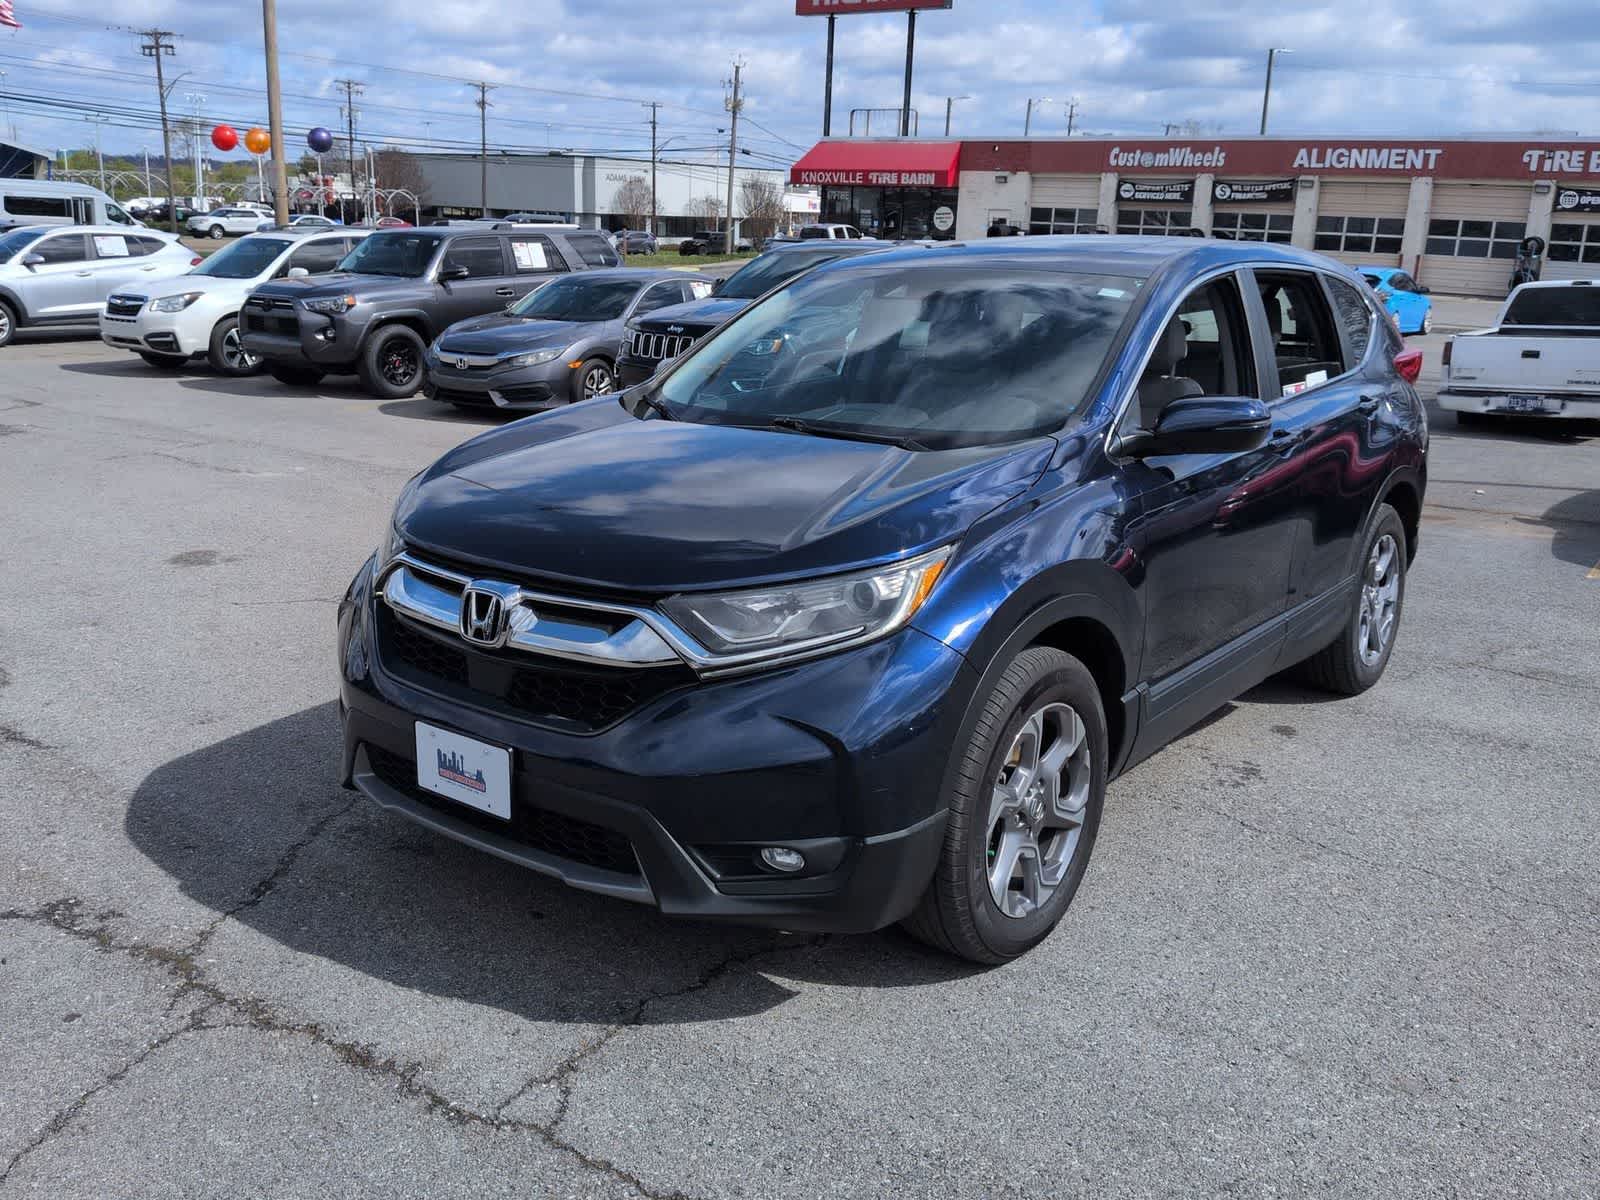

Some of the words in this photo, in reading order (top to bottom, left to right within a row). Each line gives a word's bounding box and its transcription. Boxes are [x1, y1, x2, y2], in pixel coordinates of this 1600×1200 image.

[1292, 147, 1443, 169] ALIGNMENT
[801, 171, 864, 184] KNOXVILLE
[901, 172, 936, 185] BARN
